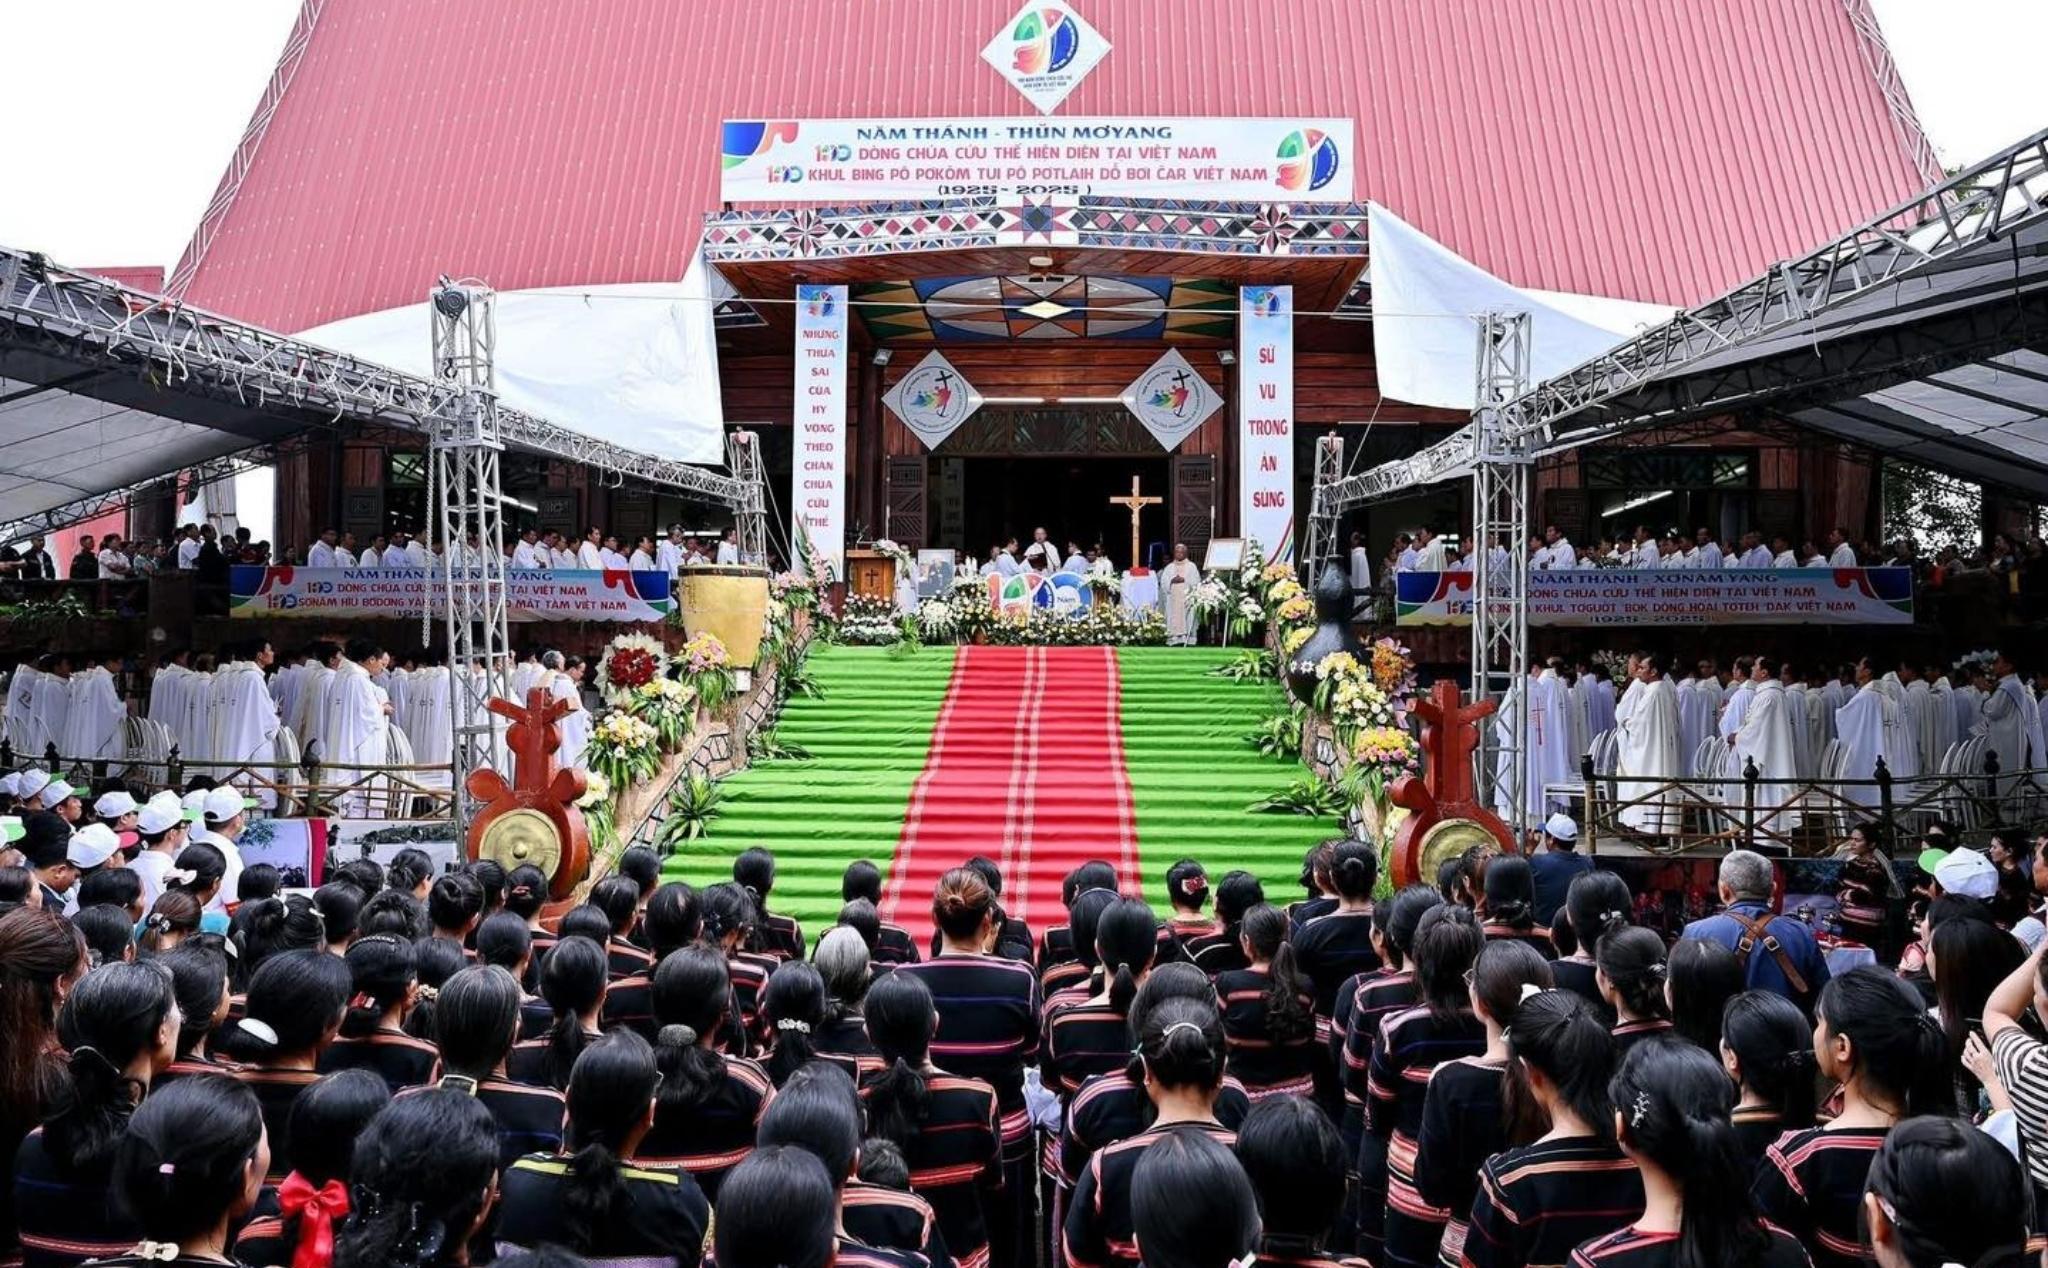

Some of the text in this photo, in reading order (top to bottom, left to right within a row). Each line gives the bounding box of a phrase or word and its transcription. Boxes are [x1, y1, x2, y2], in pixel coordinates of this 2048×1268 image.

[857, 125, 907, 140] NĂM
[913, 125, 988, 139] THÁNH
[1178, 146, 1217, 159] NAM
[808, 168, 846, 181] KHUL
[852, 168, 884, 181] BING
[977, 167, 1001, 180] TUI
[1230, 168, 1268, 181] NAM
[1247, 419, 1289, 436] TRONG
[804, 443, 834, 452] THEO
[510, 572, 553, 581] YANG
[1728, 574, 1778, 583] YANG
[560, 586, 587, 596] NAM
[1783, 587, 1816, 598] NAM
[600, 601, 627, 610] NAM
[1535, 604, 1566, 613] KHUL
[1826, 602, 1856, 612] NAM
